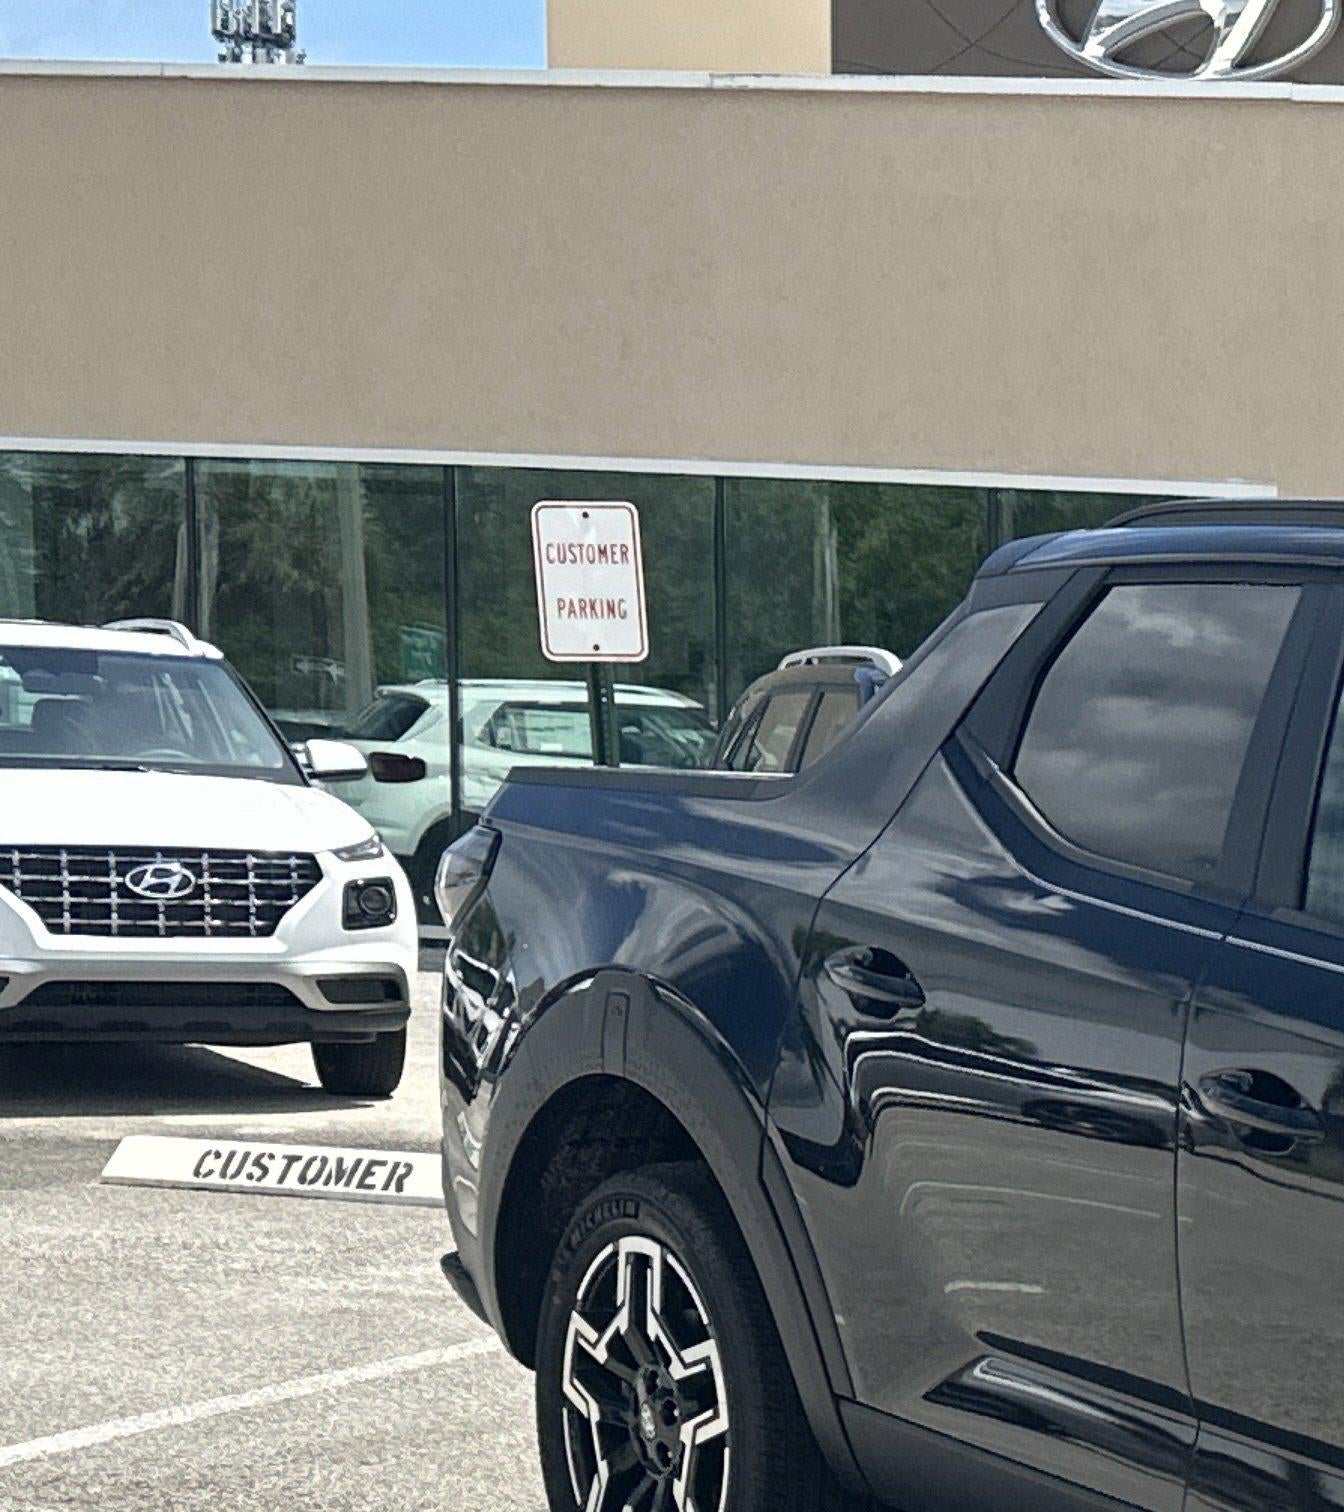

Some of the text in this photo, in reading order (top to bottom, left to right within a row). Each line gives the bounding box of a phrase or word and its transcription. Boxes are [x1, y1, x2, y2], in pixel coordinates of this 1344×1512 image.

[546, 543, 629, 564] CUSTOMER
[557, 598, 628, 620] PARKING
[192, 1149, 414, 1194] CUSTOMER
